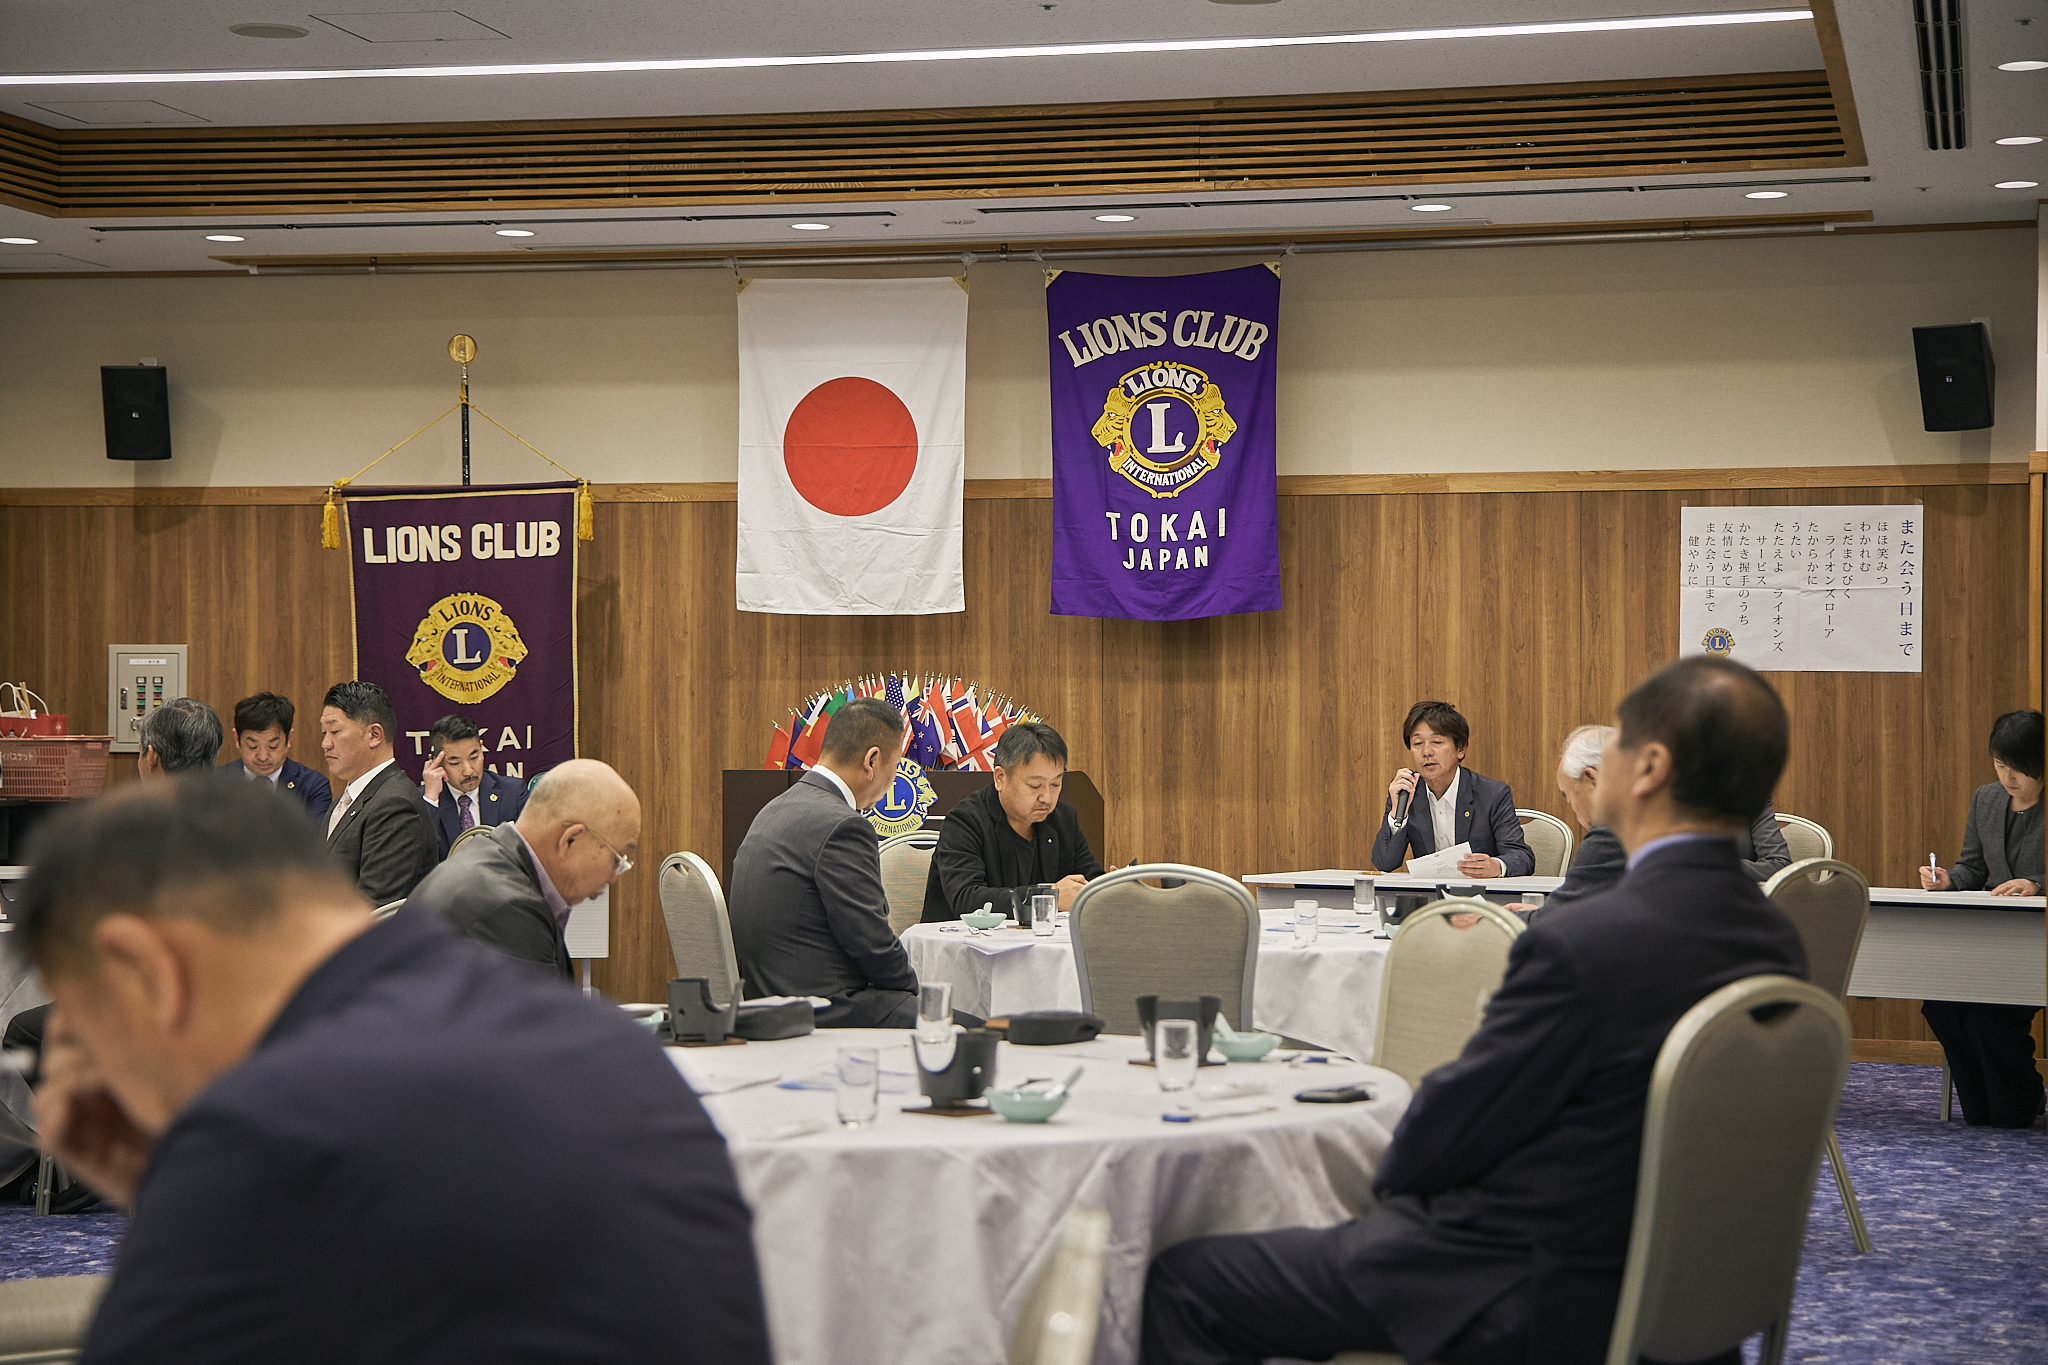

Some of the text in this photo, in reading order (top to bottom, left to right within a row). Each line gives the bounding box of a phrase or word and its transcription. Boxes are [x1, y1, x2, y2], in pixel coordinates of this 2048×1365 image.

[1058, 308, 1269, 369] LIONS CLUB
[1125, 367, 1202, 397] LIONS
[1146, 402, 1187, 454] L
[1121, 457, 1209, 488] INTERNATIONAL
[363, 520, 562, 564] LIONS CLUB
[1105, 507, 1227, 544] TOKAI
[1790, 522, 1802, 559] うたい
[1859, 522, 1871, 573] わかれむ
[1122, 545, 1210, 572] JAPAN
[1688, 535, 1699, 585] 健やかに
[1705, 522, 1716, 612] また会う日まで
[1721, 522, 1733, 586] 友情こめて
[1738, 522, 1751, 625] かたき握手のうち
[1756, 535, 1767, 585] サービス
[1807, 522, 1819, 585] たからかに
[1842, 522, 1854, 599] こだまひびく
[1877, 522, 1889, 585] ほほ笑みつ
[1772, 522, 1785, 652] たたえよ ライオンズ
[1899, 519, 1916, 657] また会う日まで
[438, 600, 495, 623] LIONS
[451, 628, 483, 665] L
[1714, 637, 1724, 649] L
[435, 670, 502, 693] INTERNATIONAL
[405, 725, 533, 755] TKAI
[884, 781, 907, 811] L
[872, 818, 920, 834] INTERNATIONAL
